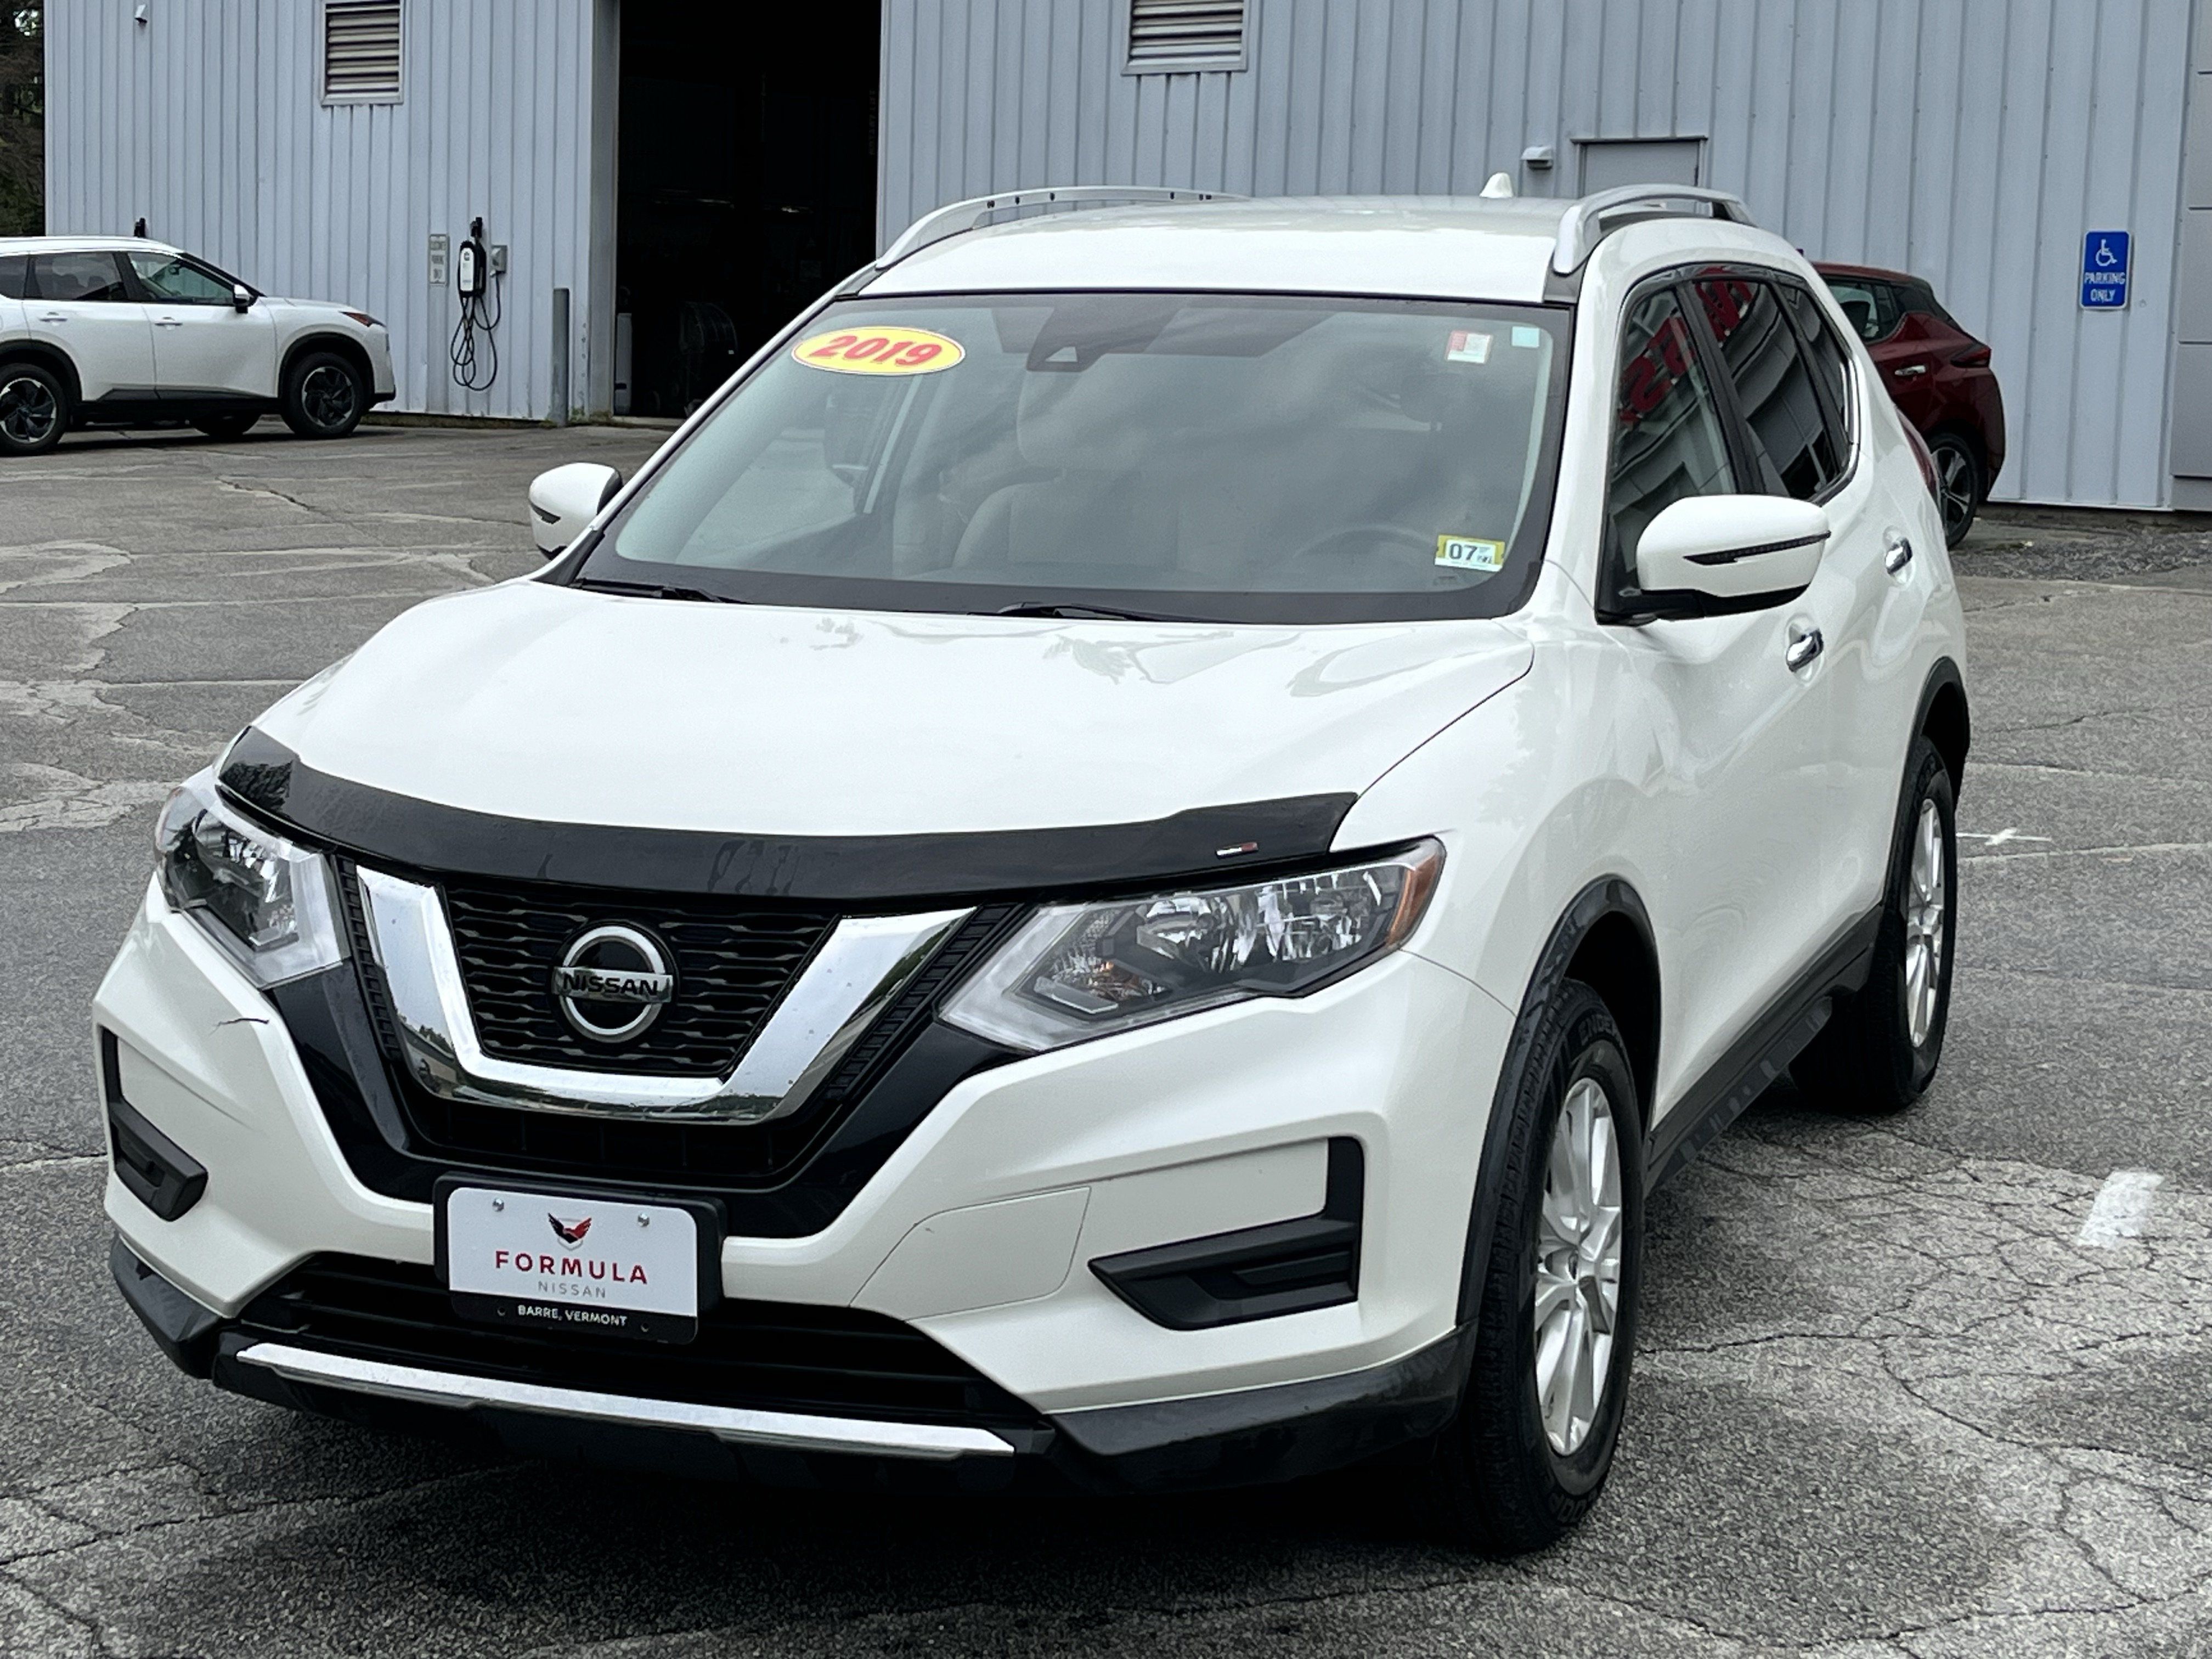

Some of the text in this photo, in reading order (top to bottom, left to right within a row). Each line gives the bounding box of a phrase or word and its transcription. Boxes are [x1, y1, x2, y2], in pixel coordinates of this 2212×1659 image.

[2085, 272, 2125, 284] PARKING
[2090, 289, 2115, 302] ONLY
[808, 335, 943, 366] 2019
[1449, 543, 1477, 561] 07
[563, 972, 658, 996] NISSAN
[495, 1250, 648, 1284] FORMULA
[538, 1281, 606, 1298] NISSAN
[518, 1305, 627, 1327] BARRE, VERMONT
